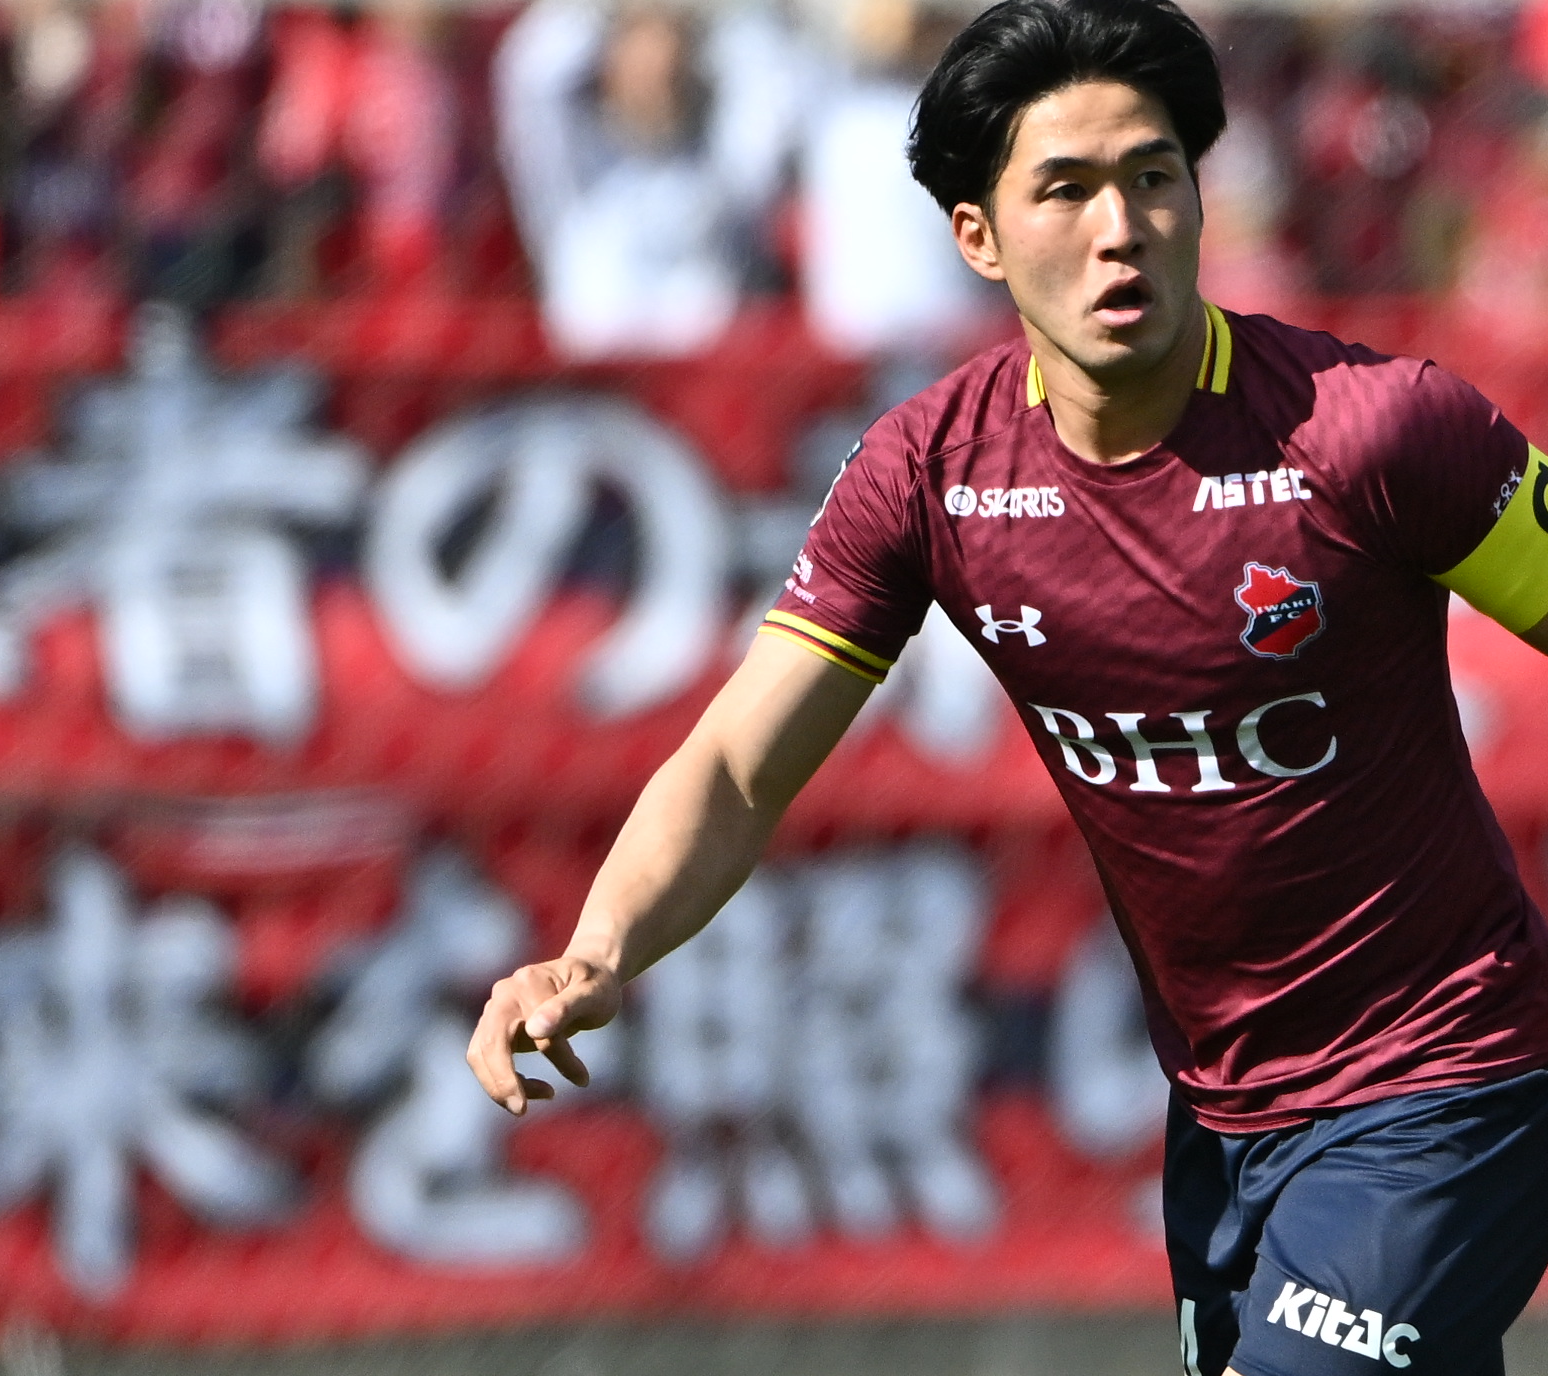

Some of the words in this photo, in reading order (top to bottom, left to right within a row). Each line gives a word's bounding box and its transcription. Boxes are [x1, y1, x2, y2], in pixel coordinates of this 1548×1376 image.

[1192, 467, 1312, 512] ASTEC
[1256, 598, 1313, 615] IWAKI
[1028, 691, 1337, 792] BHC
